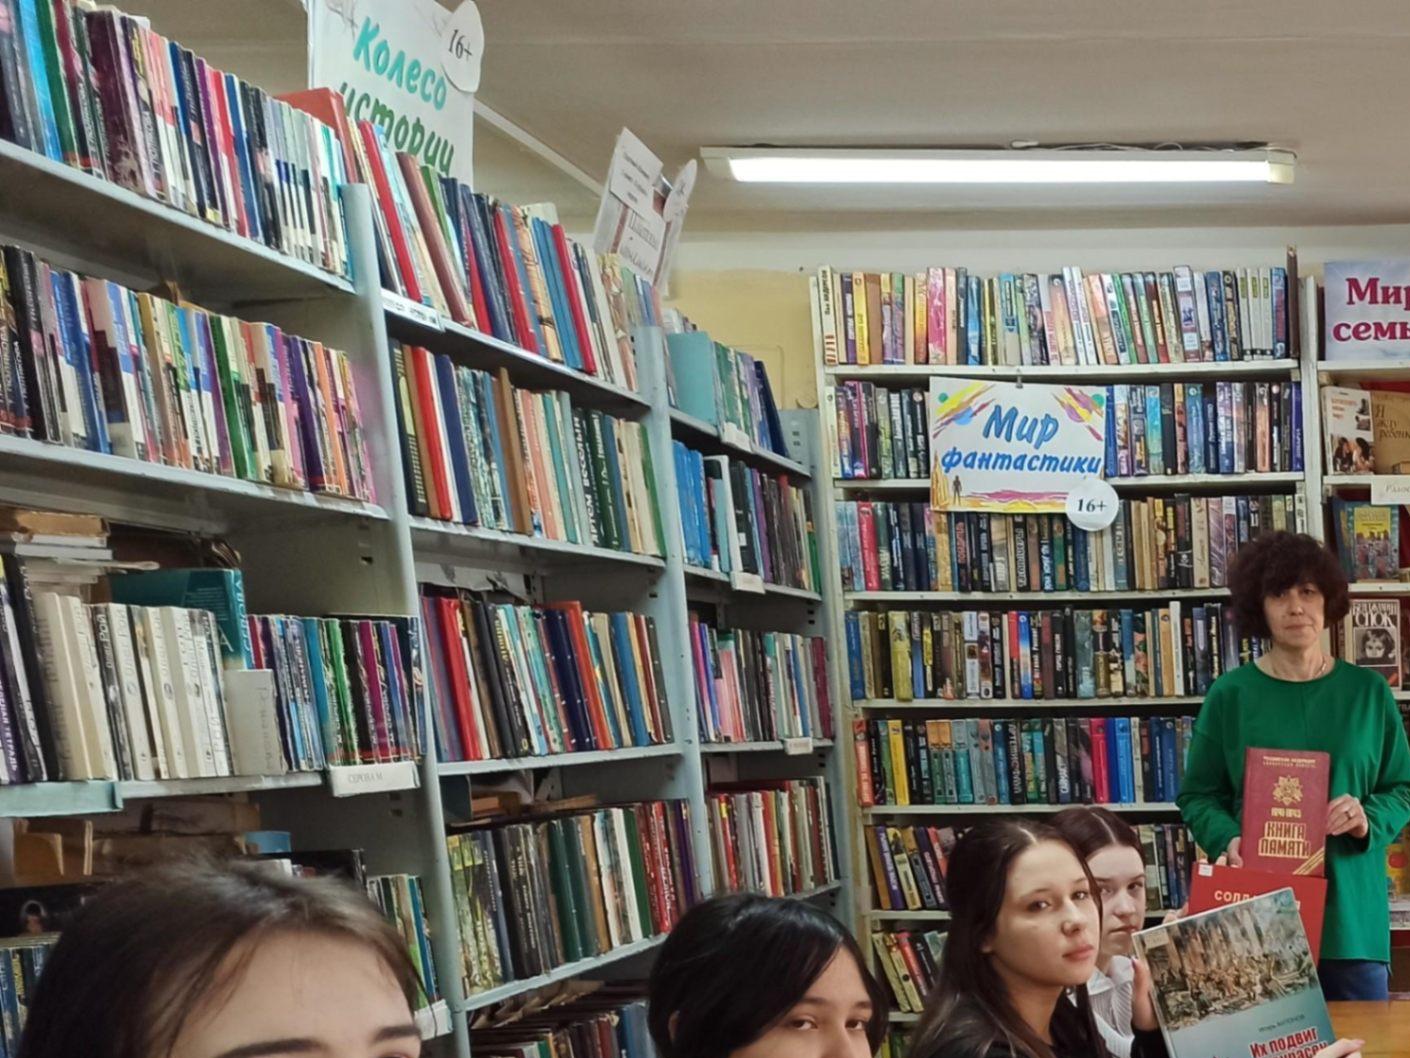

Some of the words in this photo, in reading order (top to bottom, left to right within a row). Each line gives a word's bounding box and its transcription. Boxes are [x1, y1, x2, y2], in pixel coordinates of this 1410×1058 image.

[449, 29, 472, 62] 16+
[353, 16, 447, 111] Колесо
[983, 405, 1059, 449] Мир
[941, 447, 1102, 474] фантастики
[1077, 498, 1107, 513] 16+
[1266, 821, 1306, 839] КНИГА
[1259, 838, 1311, 858] ПАМЯТИ
[1250, 1042, 1268, 1058] Их
[1269, 1027, 1318, 1054] подвиг
